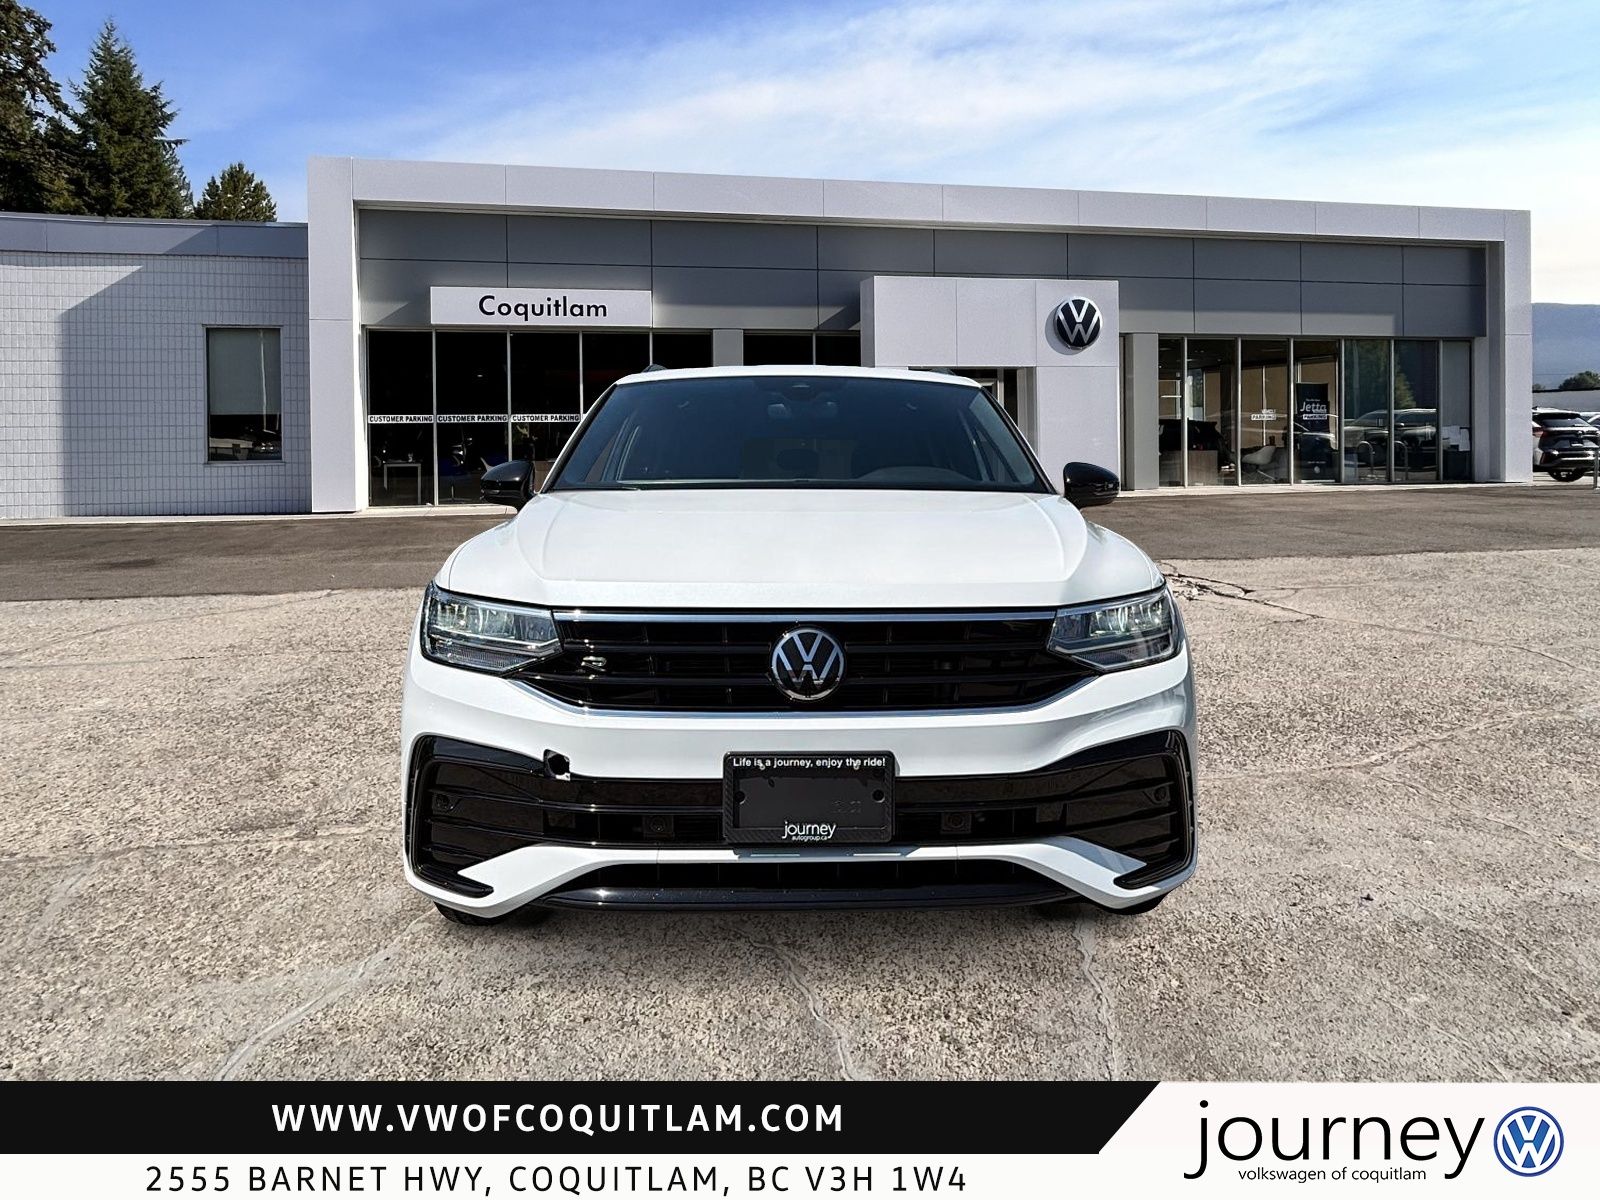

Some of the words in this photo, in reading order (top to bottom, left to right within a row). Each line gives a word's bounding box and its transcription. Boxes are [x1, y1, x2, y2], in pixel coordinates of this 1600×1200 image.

[478, 295, 608, 322] Coquitlam
[1300, 401, 1327, 412] Jetta
[369, 415, 404, 423] CUSTOMER
[405, 415, 433, 423] PARKING
[476, 414, 508, 422] PARKING
[512, 414, 549, 422] CUSTOMER
[550, 414, 580, 422] PARKING
[733, 757, 751, 767] Life
[753, 757, 763, 767] is
[765, 759, 771, 767] a
[773, 757, 814, 769] journey,
[816, 757, 843, 769] enjoy
[845, 757, 861, 767] the
[863, 757, 886, 767] ride!
[782, 821, 837, 839] journey
